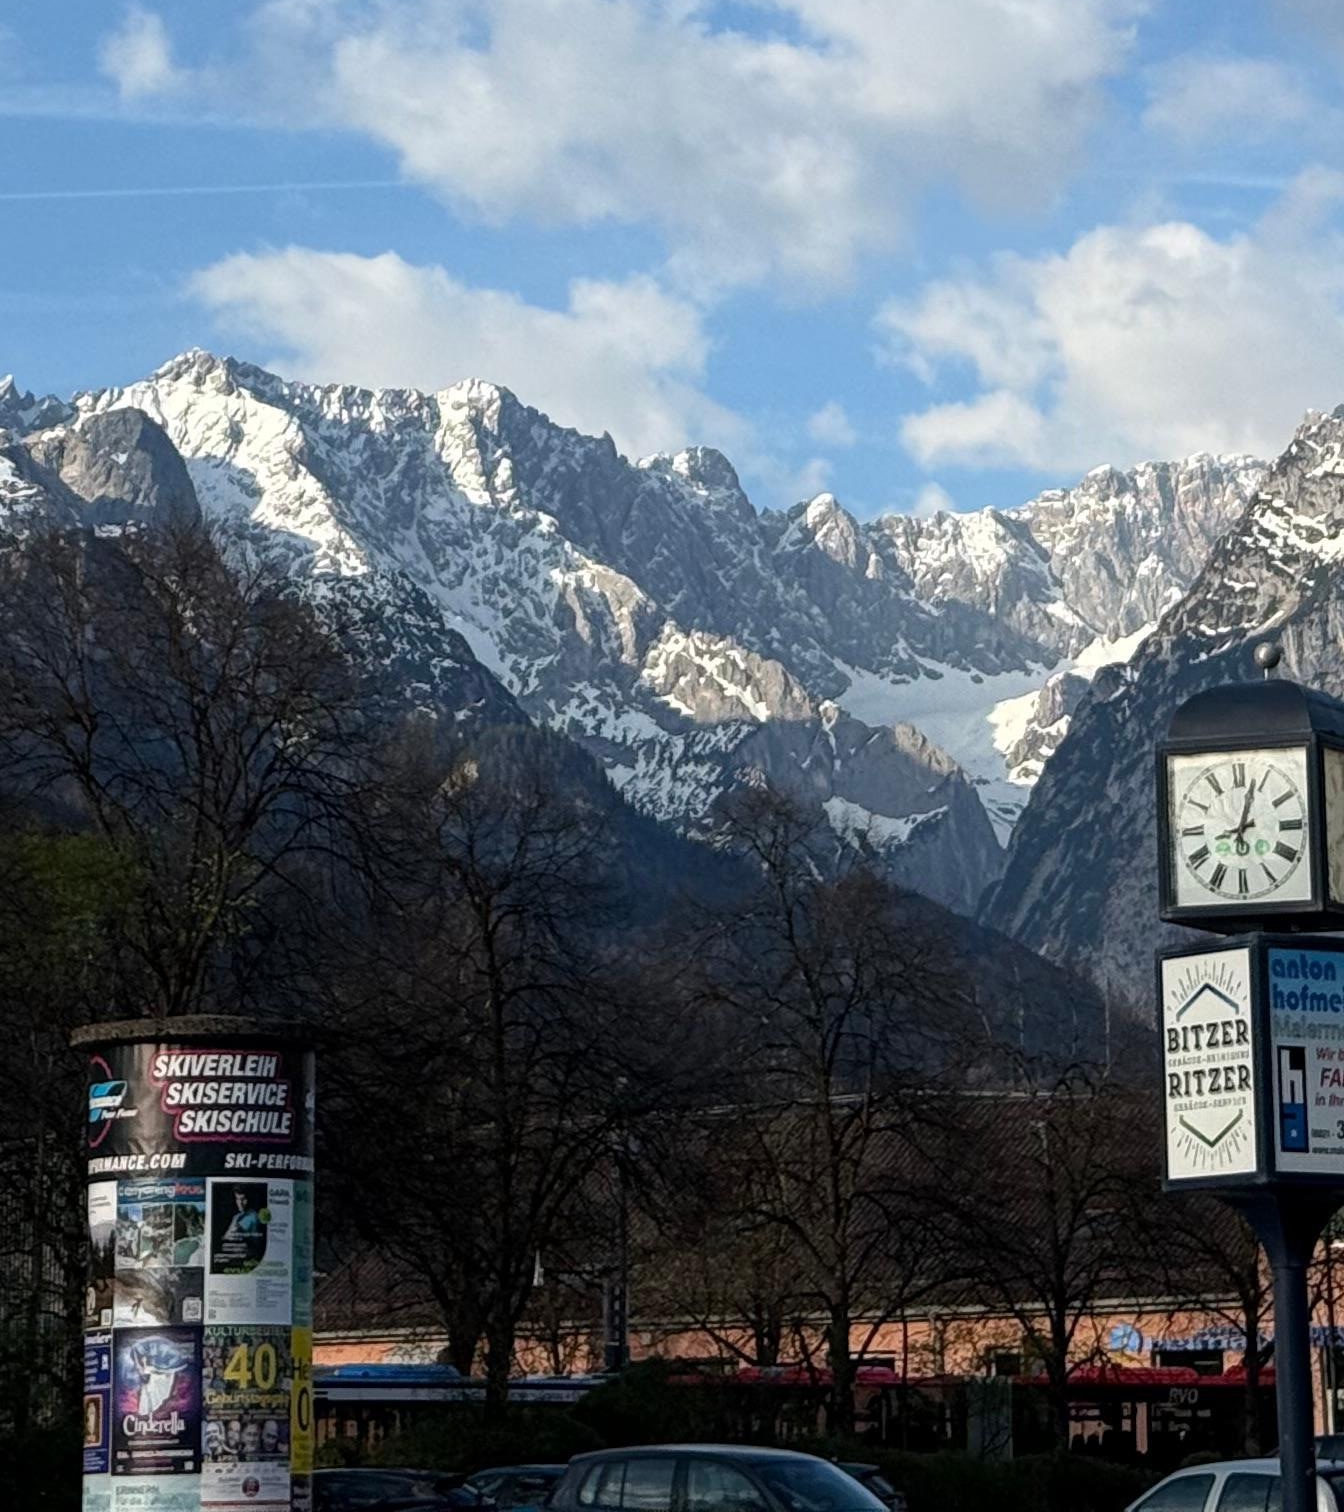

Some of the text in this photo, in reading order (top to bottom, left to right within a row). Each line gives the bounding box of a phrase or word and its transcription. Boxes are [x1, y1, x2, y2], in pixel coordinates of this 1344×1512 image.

[1272, 953, 1336, 981] anton
[1167, 1019, 1249, 1054] BITZER
[153, 1054, 277, 1078] SKIVERLEIH
[1316, 1047, 1336, 1061] Wir
[1168, 1064, 1252, 1099] RITZER
[165, 1082, 288, 1106] SKISERVICE
[1316, 1092, 1326, 1106] in
[179, 1110, 292, 1134] SKISCHULE
[223, 1343, 277, 1389] 40
[122, 1411, 186, 1436] Cinderella
